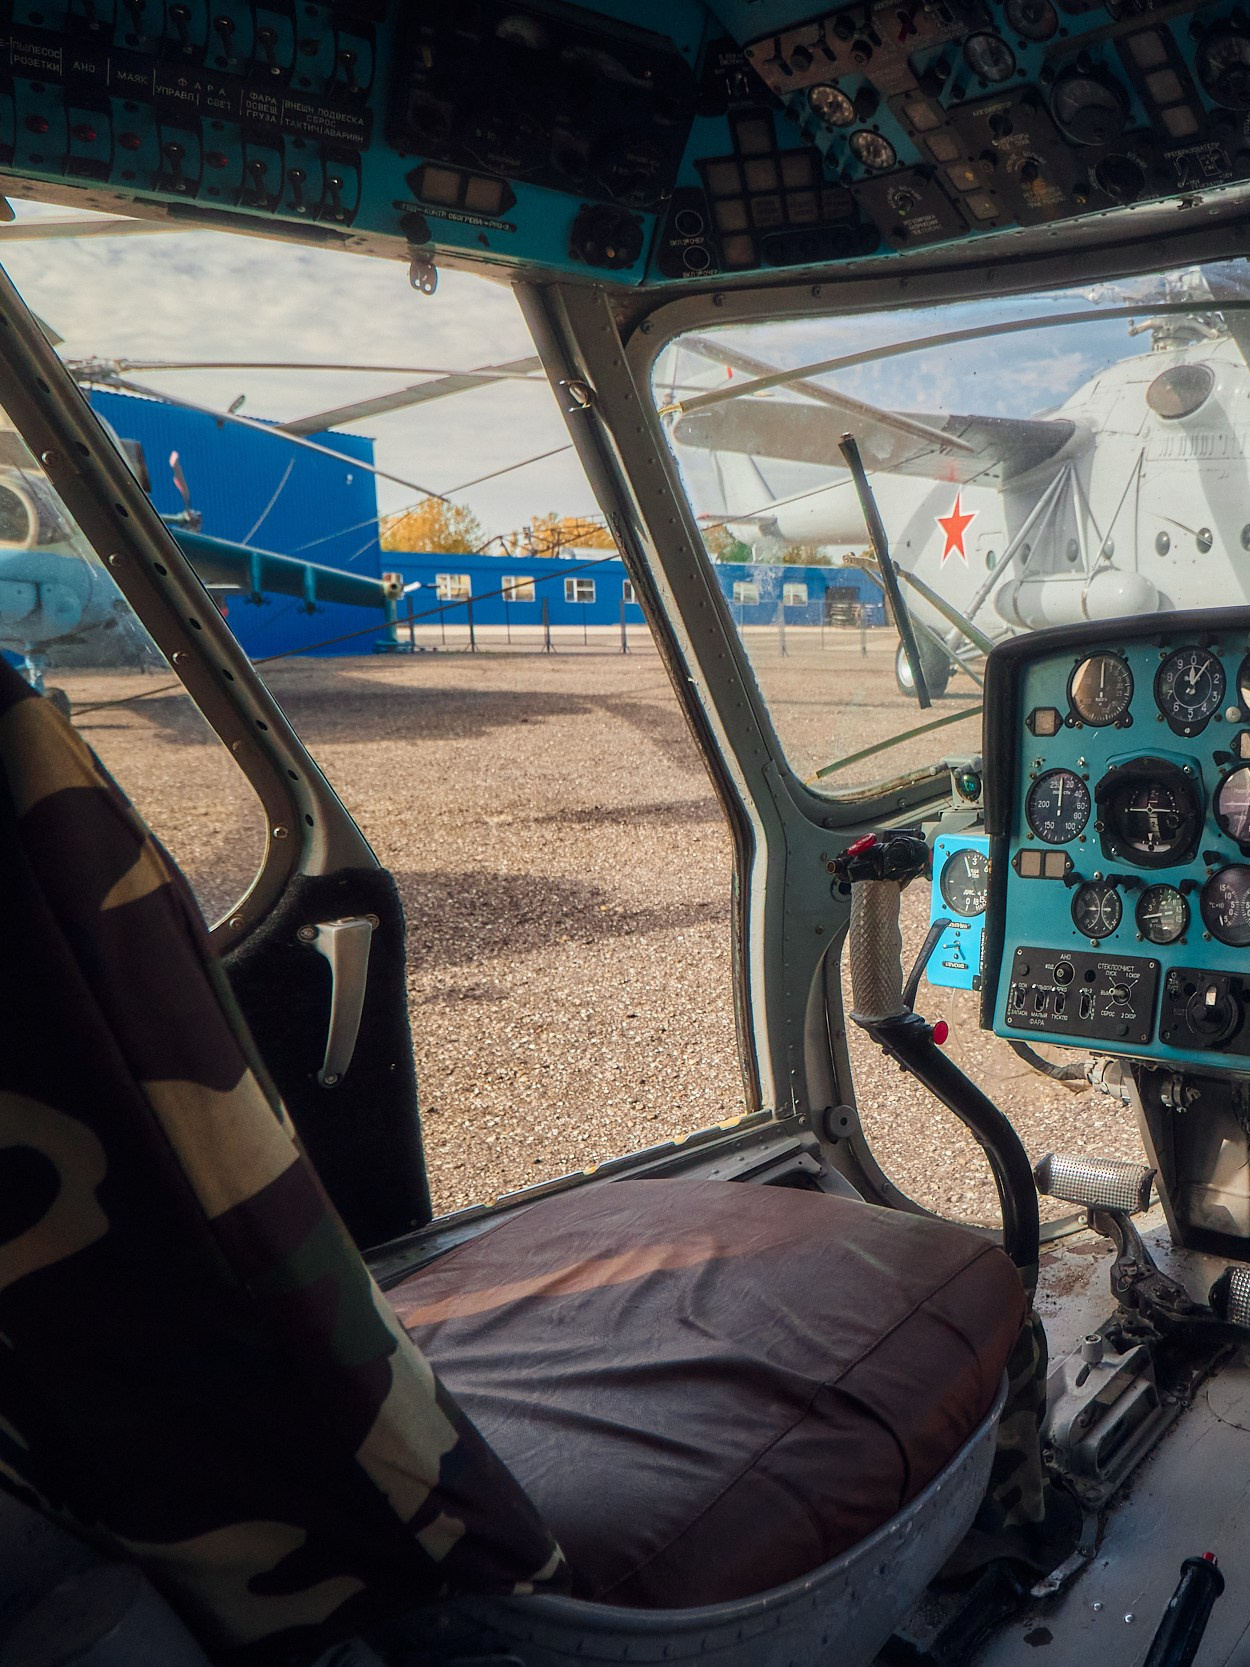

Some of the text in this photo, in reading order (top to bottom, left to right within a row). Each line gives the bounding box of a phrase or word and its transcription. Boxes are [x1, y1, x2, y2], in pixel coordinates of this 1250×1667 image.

[14, 56, 60, 72] РОЗЕТКИ
[73, 61, 96, 73] АНО
[117, 70, 148, 85] МАЯК
[249, 92, 277, 104] ФАРА
[207, 97, 231, 110] СВЕТ
[246, 111, 277, 124] ГРУЗА
[285, 102, 364, 126] ВНЕШН ПОДВЕСКА
[306, 115, 336, 128] СБРОС
[448, 212, 483, 226] ОБОГРЕВА
[1177, 659, 1184, 670] 9
[1190, 655, 1197, 665] 0
[1166, 672, 1173, 682] 8
[1213, 673, 1220, 684] 2
[1167, 690, 1173, 700] 7
[1211, 691, 1218, 702] 3
[1173, 701, 1180, 712] 6
[1201, 702, 1207, 712] 4
[1187, 708, 1194, 718] 5
[1066, 780, 1075, 788] 20
[1074, 790, 1083, 798] 40
[1037, 800, 1050, 808] 200
[1077, 802, 1086, 810] 60
[1044, 821, 1055, 829] 150
[1065, 822, 1076, 830] 100
[1219, 884, 1226, 892] 15
[1224, 892, 1232, 900] 10
[1148, 904, 1153, 912] 3
[1230, 901, 1235, 909] 5
[1245, 901, 1250, 909] 5
[1228, 908, 1234, 916] 0
[1060, 953, 1072, 961] АНО
[1098, 962, 1134, 972] СТЕКЛООЧИСТ
[1029, 1018, 1044, 1026] ФАРА
